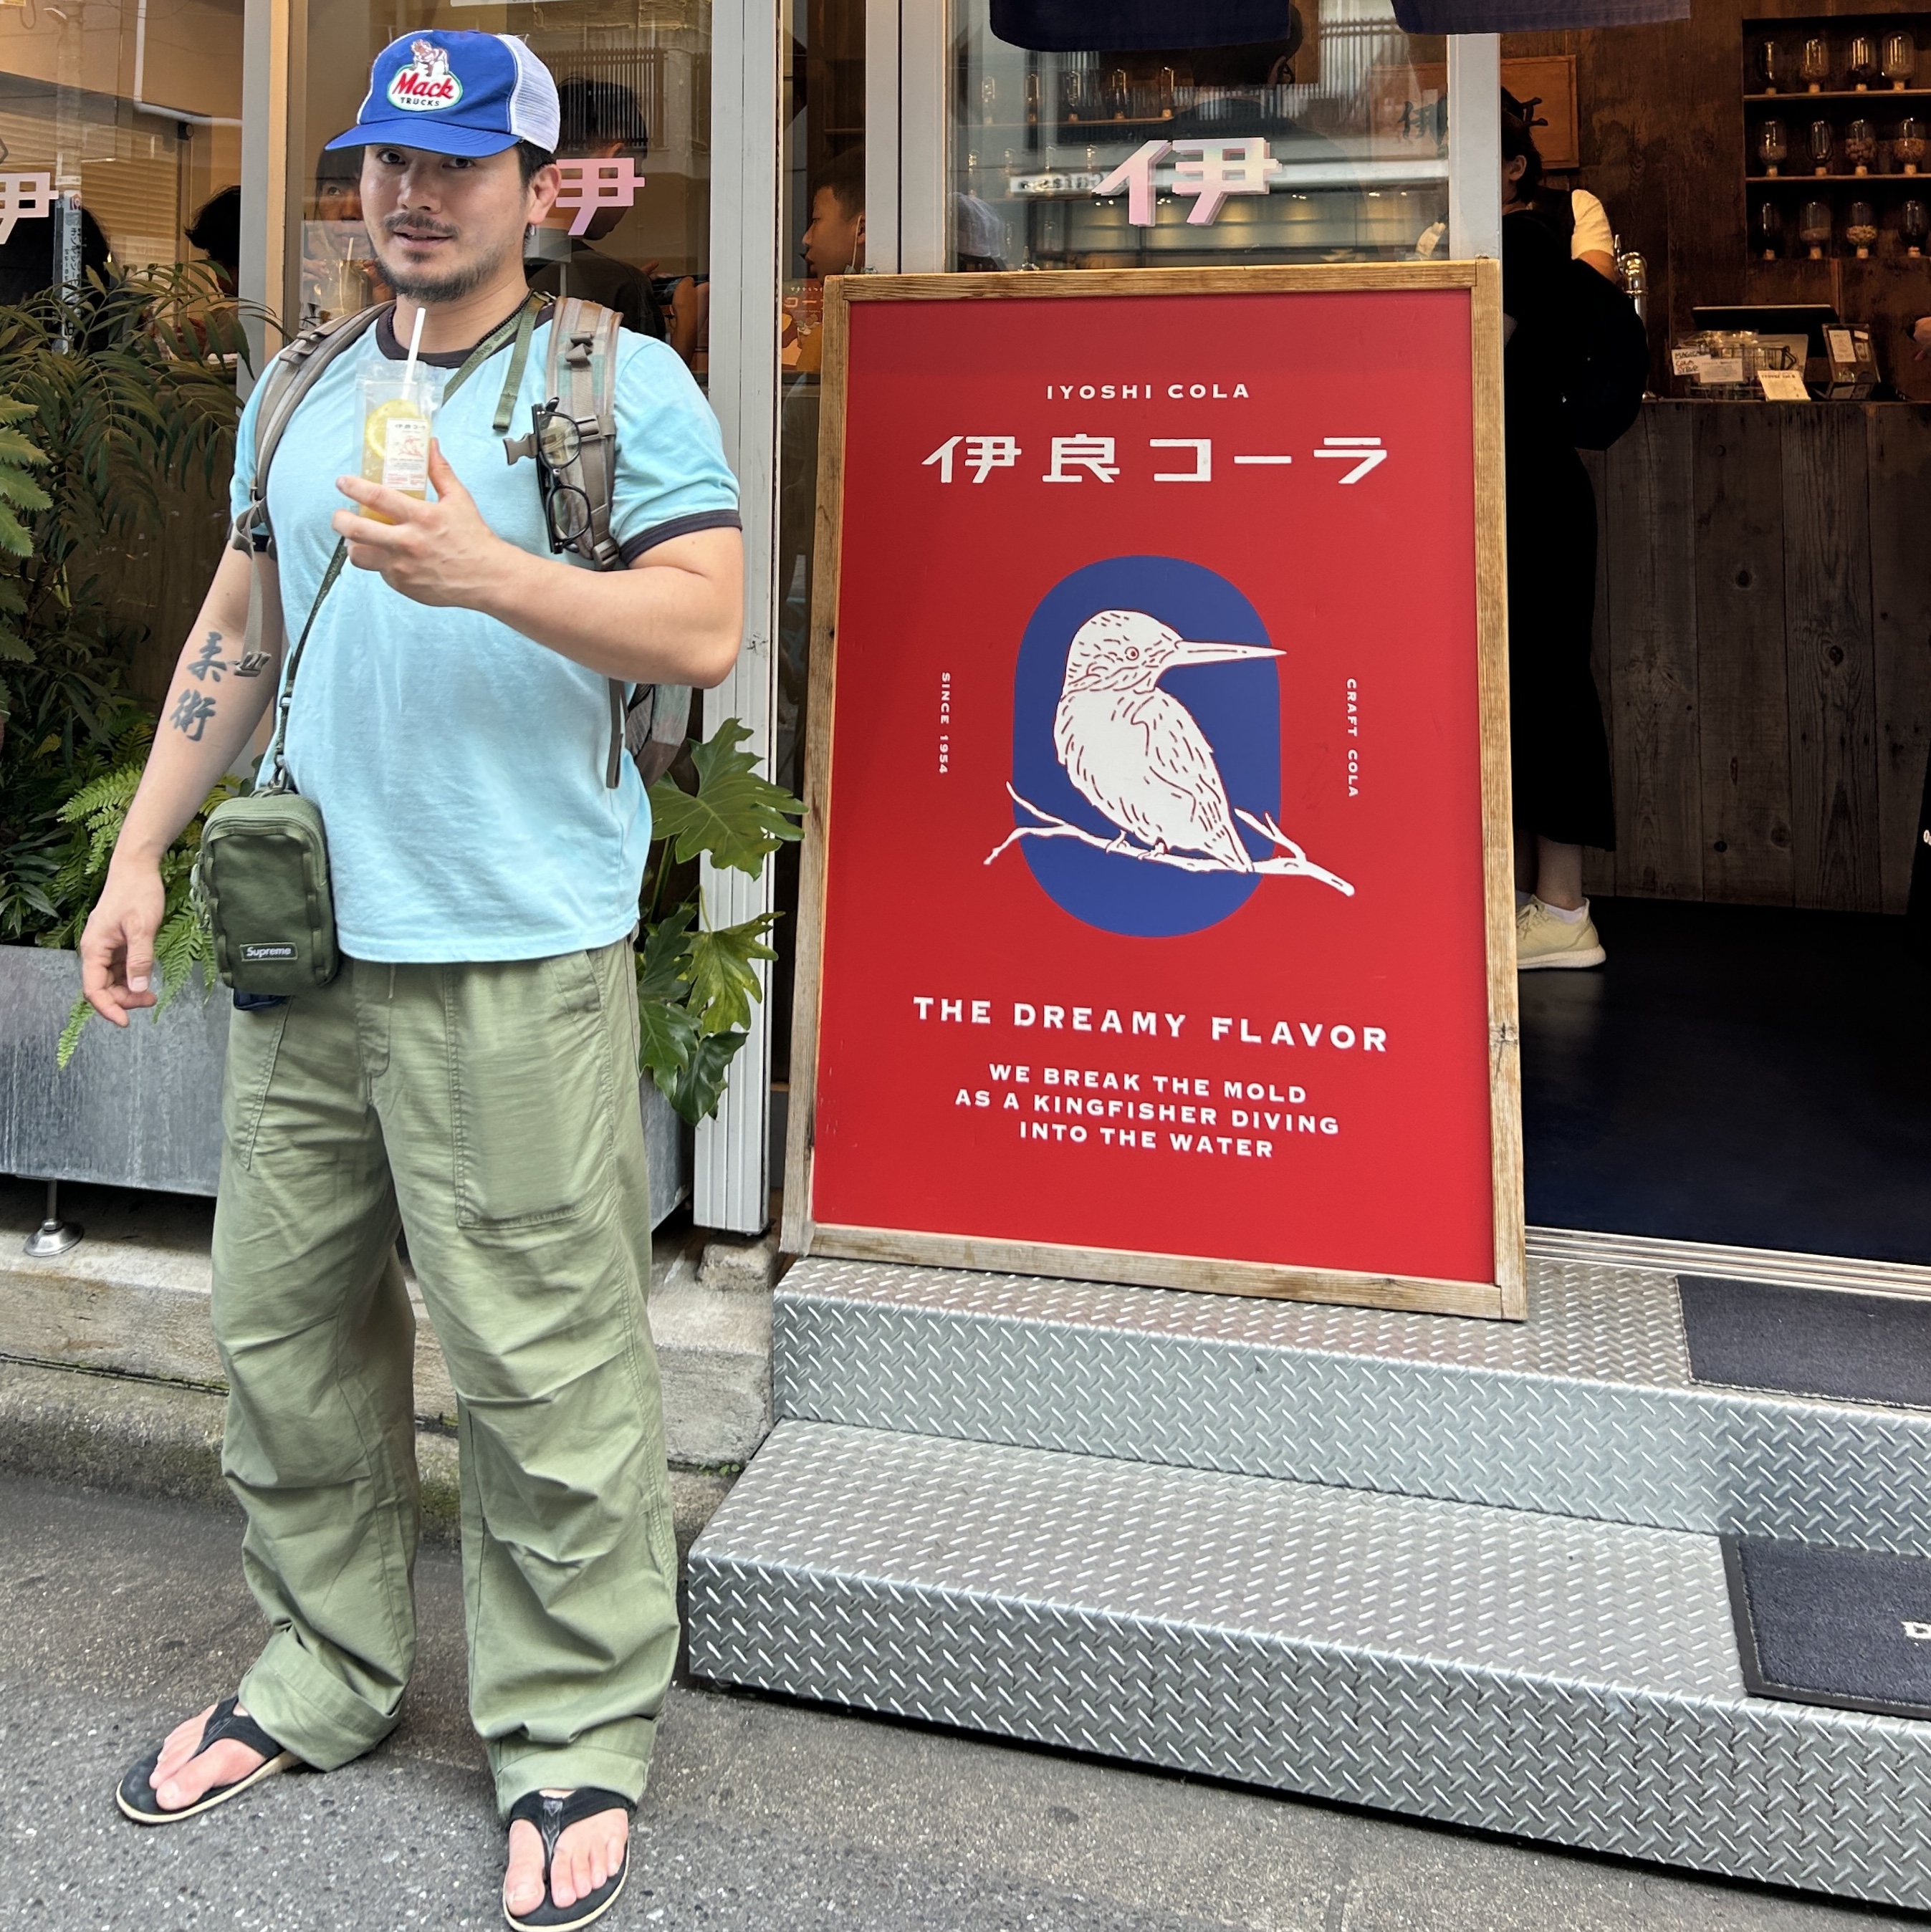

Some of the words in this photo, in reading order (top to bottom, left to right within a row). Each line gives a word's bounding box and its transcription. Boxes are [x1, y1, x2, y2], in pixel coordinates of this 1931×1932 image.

[392, 72, 454, 100] Mack
[401, 97, 440, 107] TRUCKS
[1091, 137, 1281, 226] 伊
[1047, 384, 1152, 400] IYOSHI
[1167, 383, 1250, 399] COLA
[921, 433, 1387, 484] 伊良コーラ
[940, 672, 951, 724] SINCE
[1346, 678, 1358, 737] CRAFT
[939, 734, 949, 774] 1954
[1347, 749, 1359, 797] COLA
[246, 946, 292, 958] Supreme
[913, 996, 991, 1024] THE
[1014, 1003, 1187, 1037] DREAMY
[1212, 1017, 1389, 1052] FLAVOR
[989, 1063, 1030, 1083] WE
[1044, 1067, 1141, 1091] BREAK
[1152, 1075, 1209, 1097] THE
[1224, 1080, 1307, 1103] MOLD
[955, 1089, 990, 1107] AS
[1003, 1092, 1020, 1110] A
[1034, 1094, 1217, 1125] KINGFISHER
[1232, 1110, 1339, 1135] DIVING
[1020, 1121, 1088, 1143] INTO
[1099, 1127, 1156, 1149] THE
[1169, 1133, 1273, 1158] WATER
